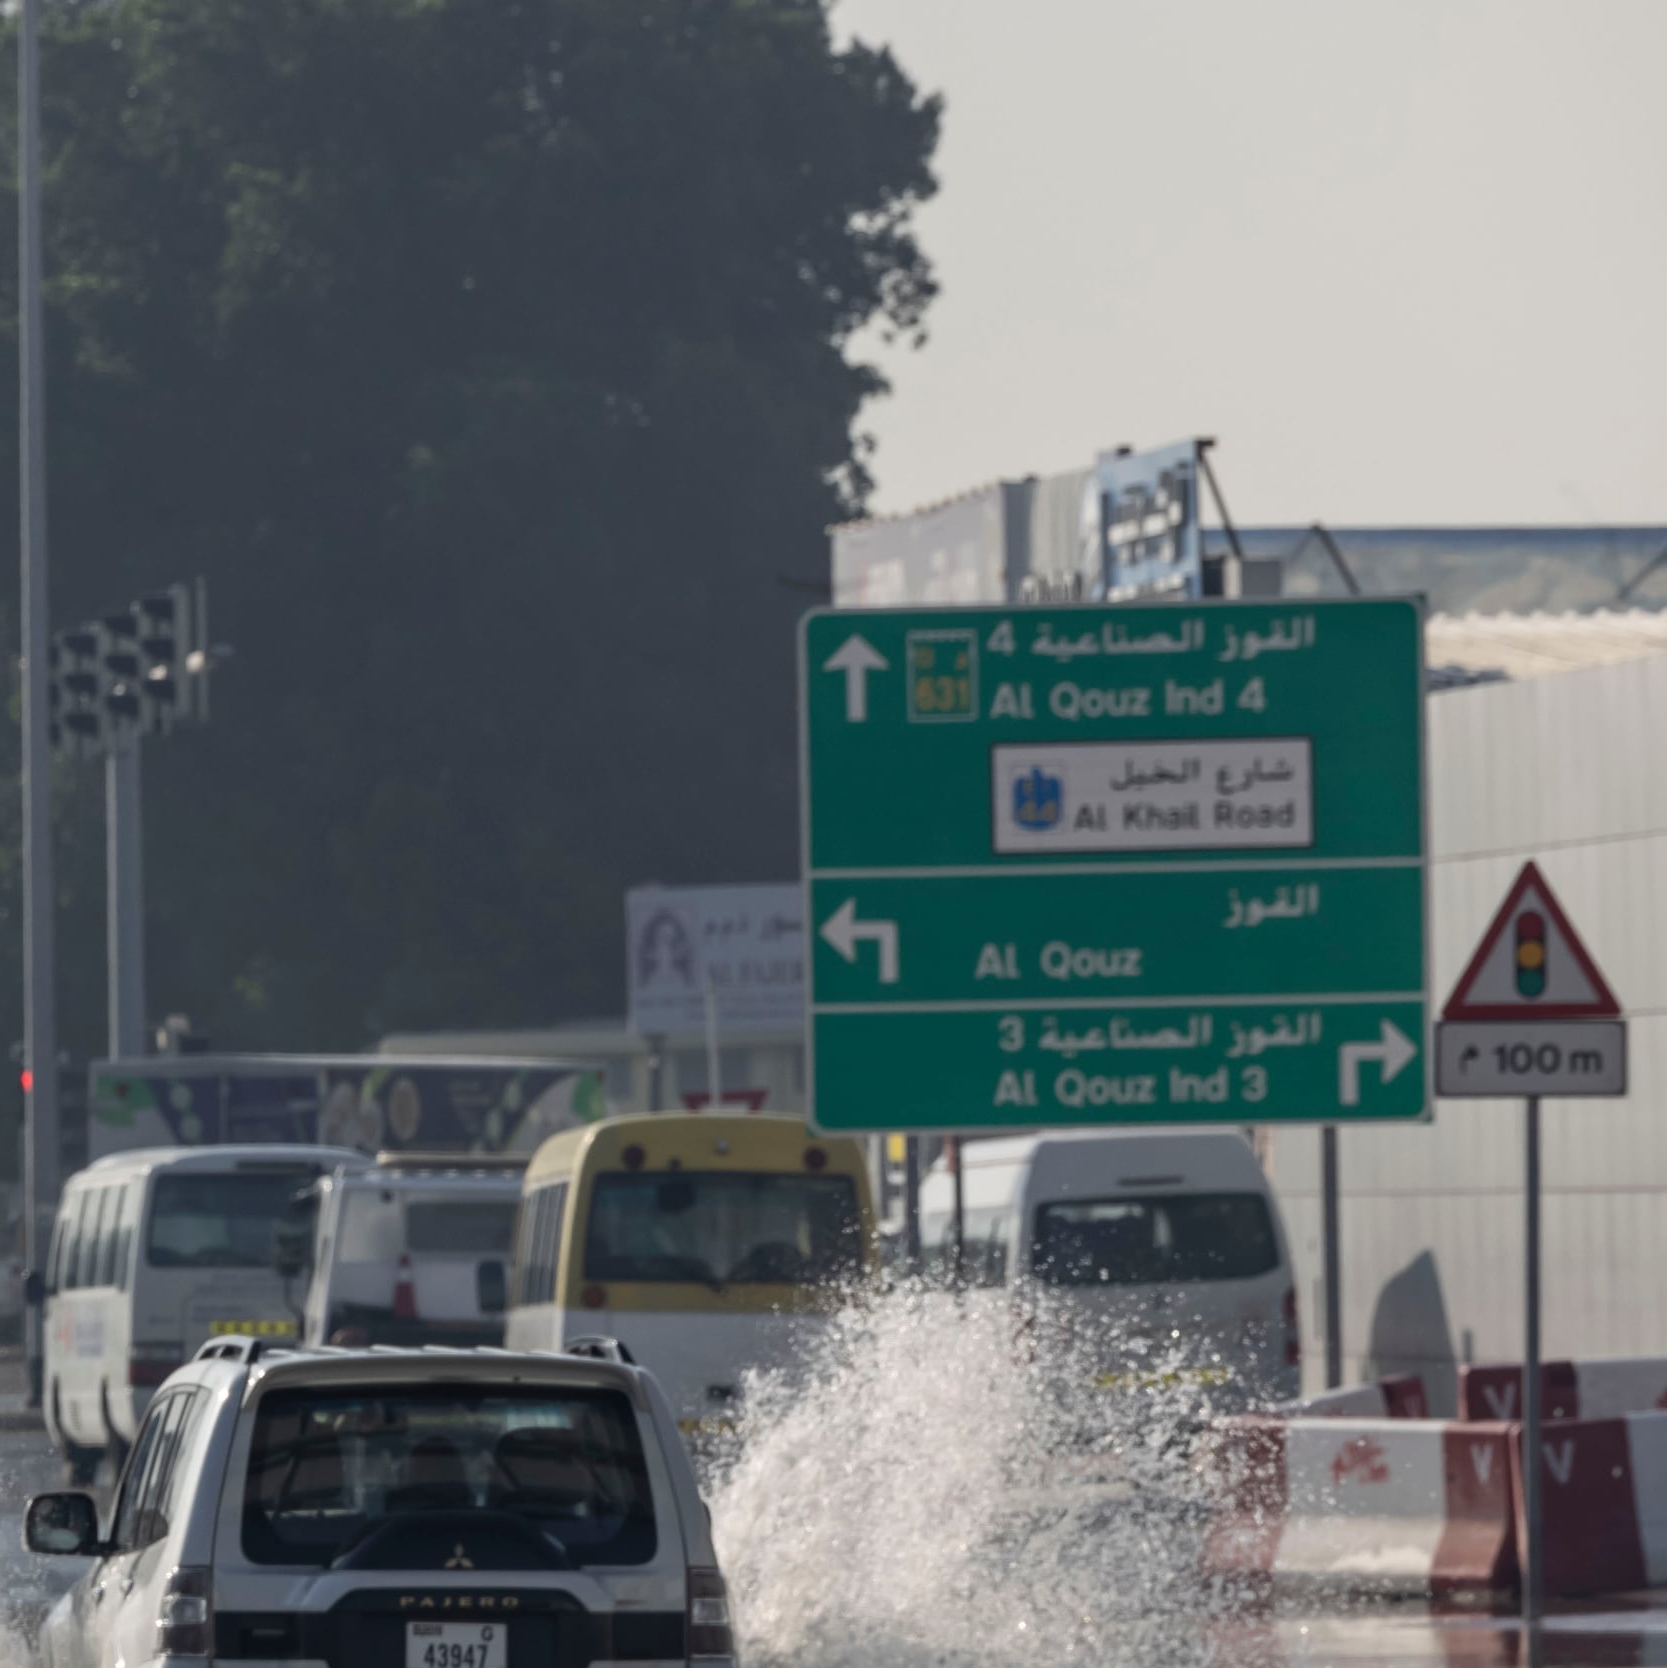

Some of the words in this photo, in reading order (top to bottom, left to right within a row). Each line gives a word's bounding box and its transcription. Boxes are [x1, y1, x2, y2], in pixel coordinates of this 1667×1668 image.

[987, 619, 1015, 656] 4
[1031, 618, 1207, 662] الصناعية
[1218, 614, 1316, 662] القوز
[989, 682, 1035, 719] Al
[1049, 680, 1152, 720] Qouz
[1164, 676, 1223, 716] Ind
[1238, 675, 1266, 714] 4
[1109, 758, 1201, 792] الخيل
[1214, 758, 1295, 795] شارع
[1073, 802, 1107, 832] Al
[1122, 800, 1200, 831] Khail
[1214, 799, 1295, 829] Road
[1222, 882, 1320, 929] القوز
[974, 943, 1020, 980] Al
[1040, 940, 1144, 982] Qouz
[998, 1015, 1025, 1052] 3
[1038, 1013, 1214, 1059] الصناعية
[1225, 1011, 1323, 1058] القوز
[1492, 1041, 1562, 1074] 100
[1568, 1048, 1603, 1074] m
[993, 1069, 1038, 1107] Al
[1054, 1067, 1157, 1108] Qouz
[1169, 1066, 1229, 1104] Ind
[1241, 1066, 1267, 1104] 3
[399, 1596, 520, 1608] PAJERO
[423, 1643, 489, 1668] 43947
